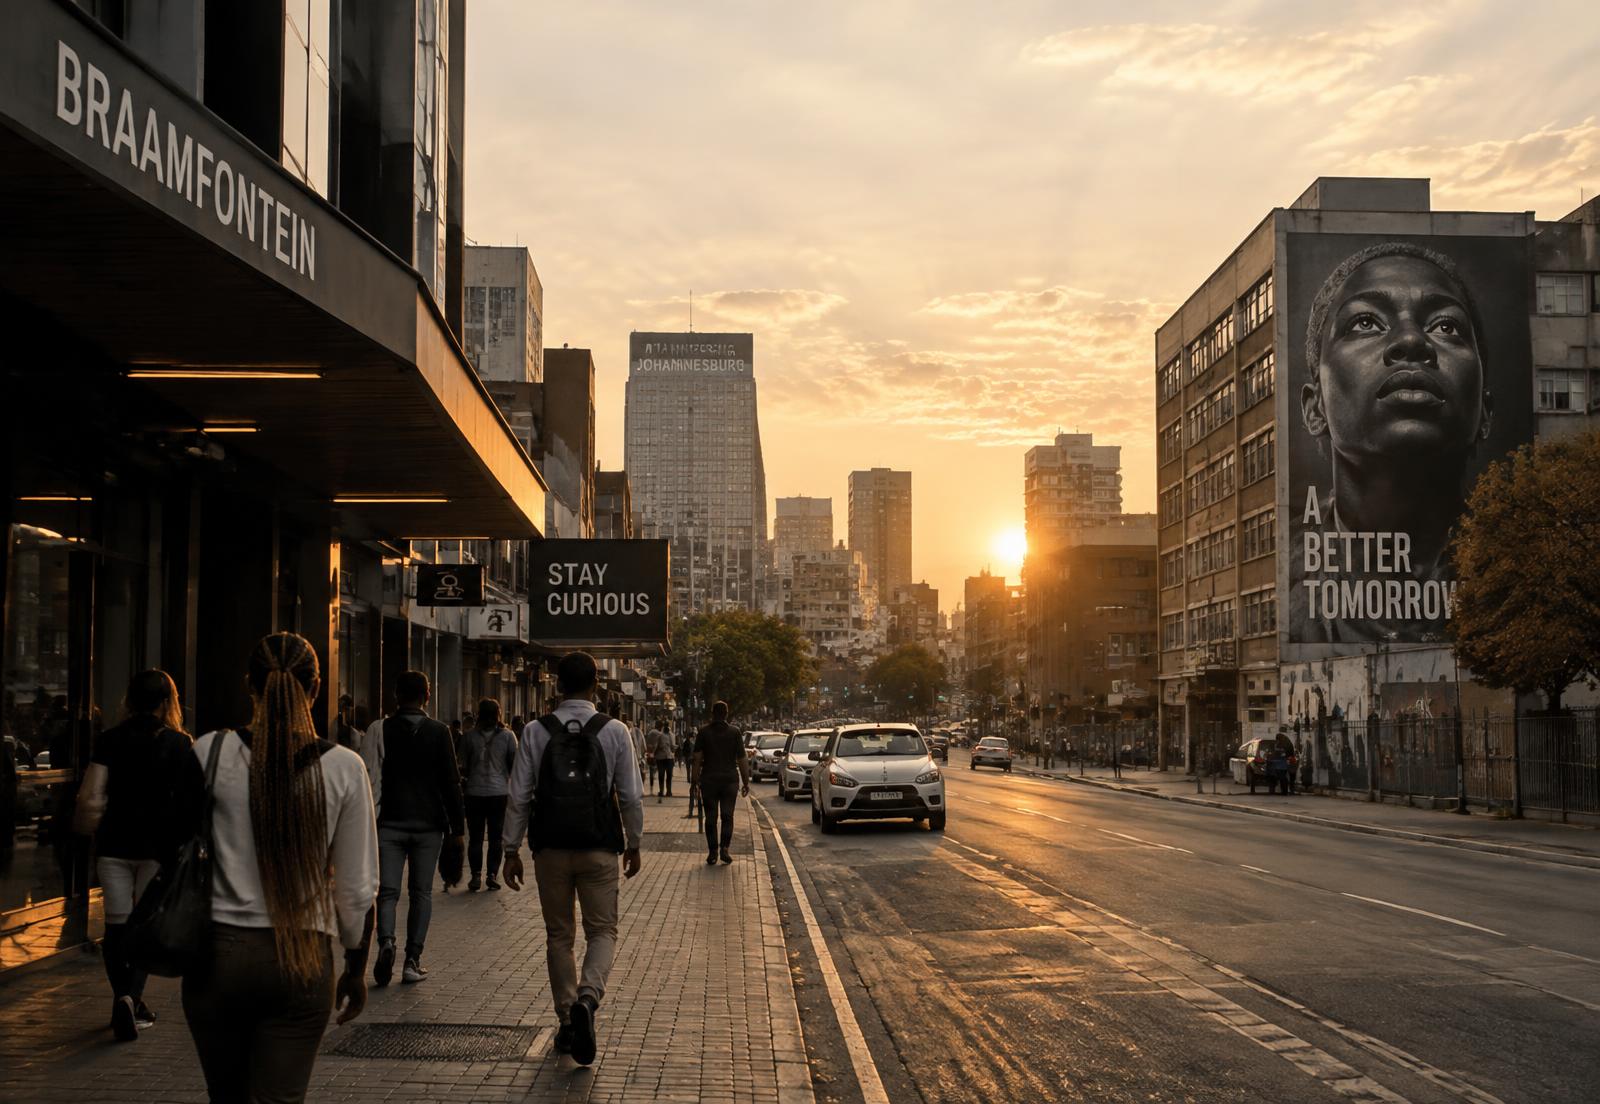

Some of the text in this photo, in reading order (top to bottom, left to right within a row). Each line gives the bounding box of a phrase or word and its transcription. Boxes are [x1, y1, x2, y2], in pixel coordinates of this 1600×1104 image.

[57, 40, 314, 281] BRAAMFONTEIN
[1303, 486, 1322, 524] A
[1304, 532, 1412, 573] BETTER
[548, 563, 608, 586] STAY
[547, 592, 650, 616] CURIOUS
